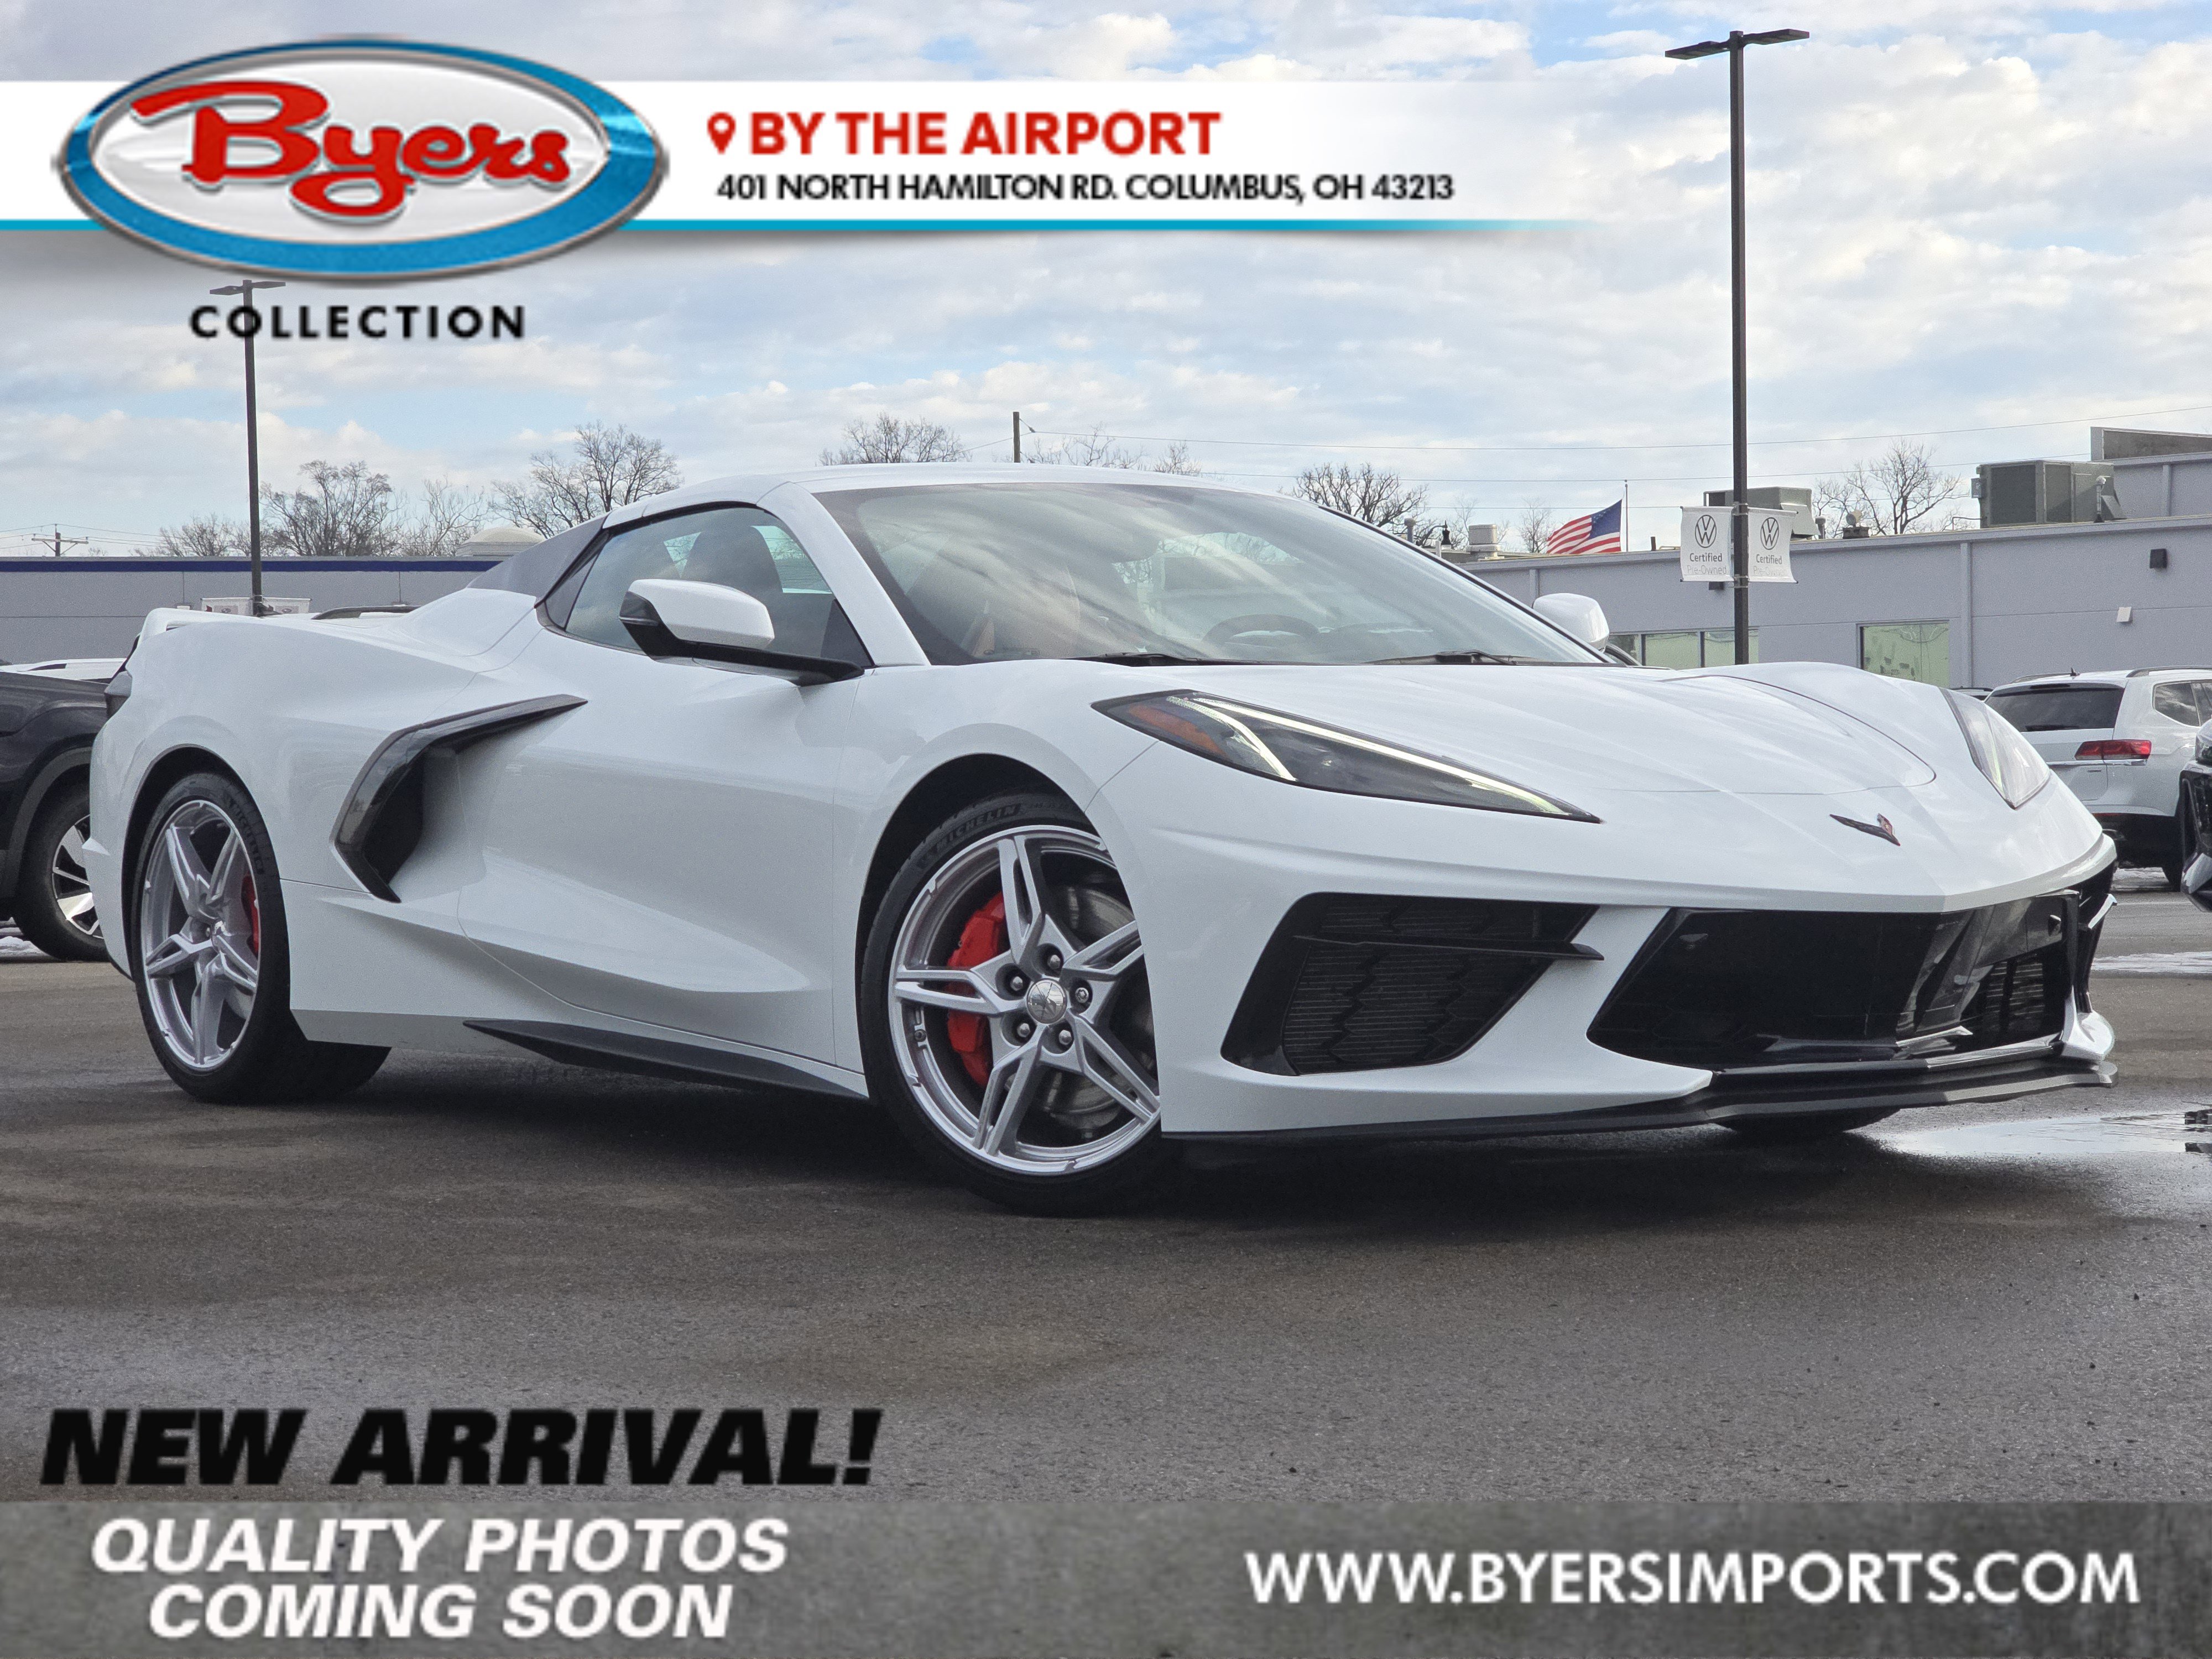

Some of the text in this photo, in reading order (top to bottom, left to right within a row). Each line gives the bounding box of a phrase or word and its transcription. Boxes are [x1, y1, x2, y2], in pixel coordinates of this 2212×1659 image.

[1689, 552, 1723, 562] Certified
[1756, 554, 1782, 565] Certified
[1687, 565, 1727, 575] Pre-Owned
[936, 805, 1016, 849] MICHELIN
